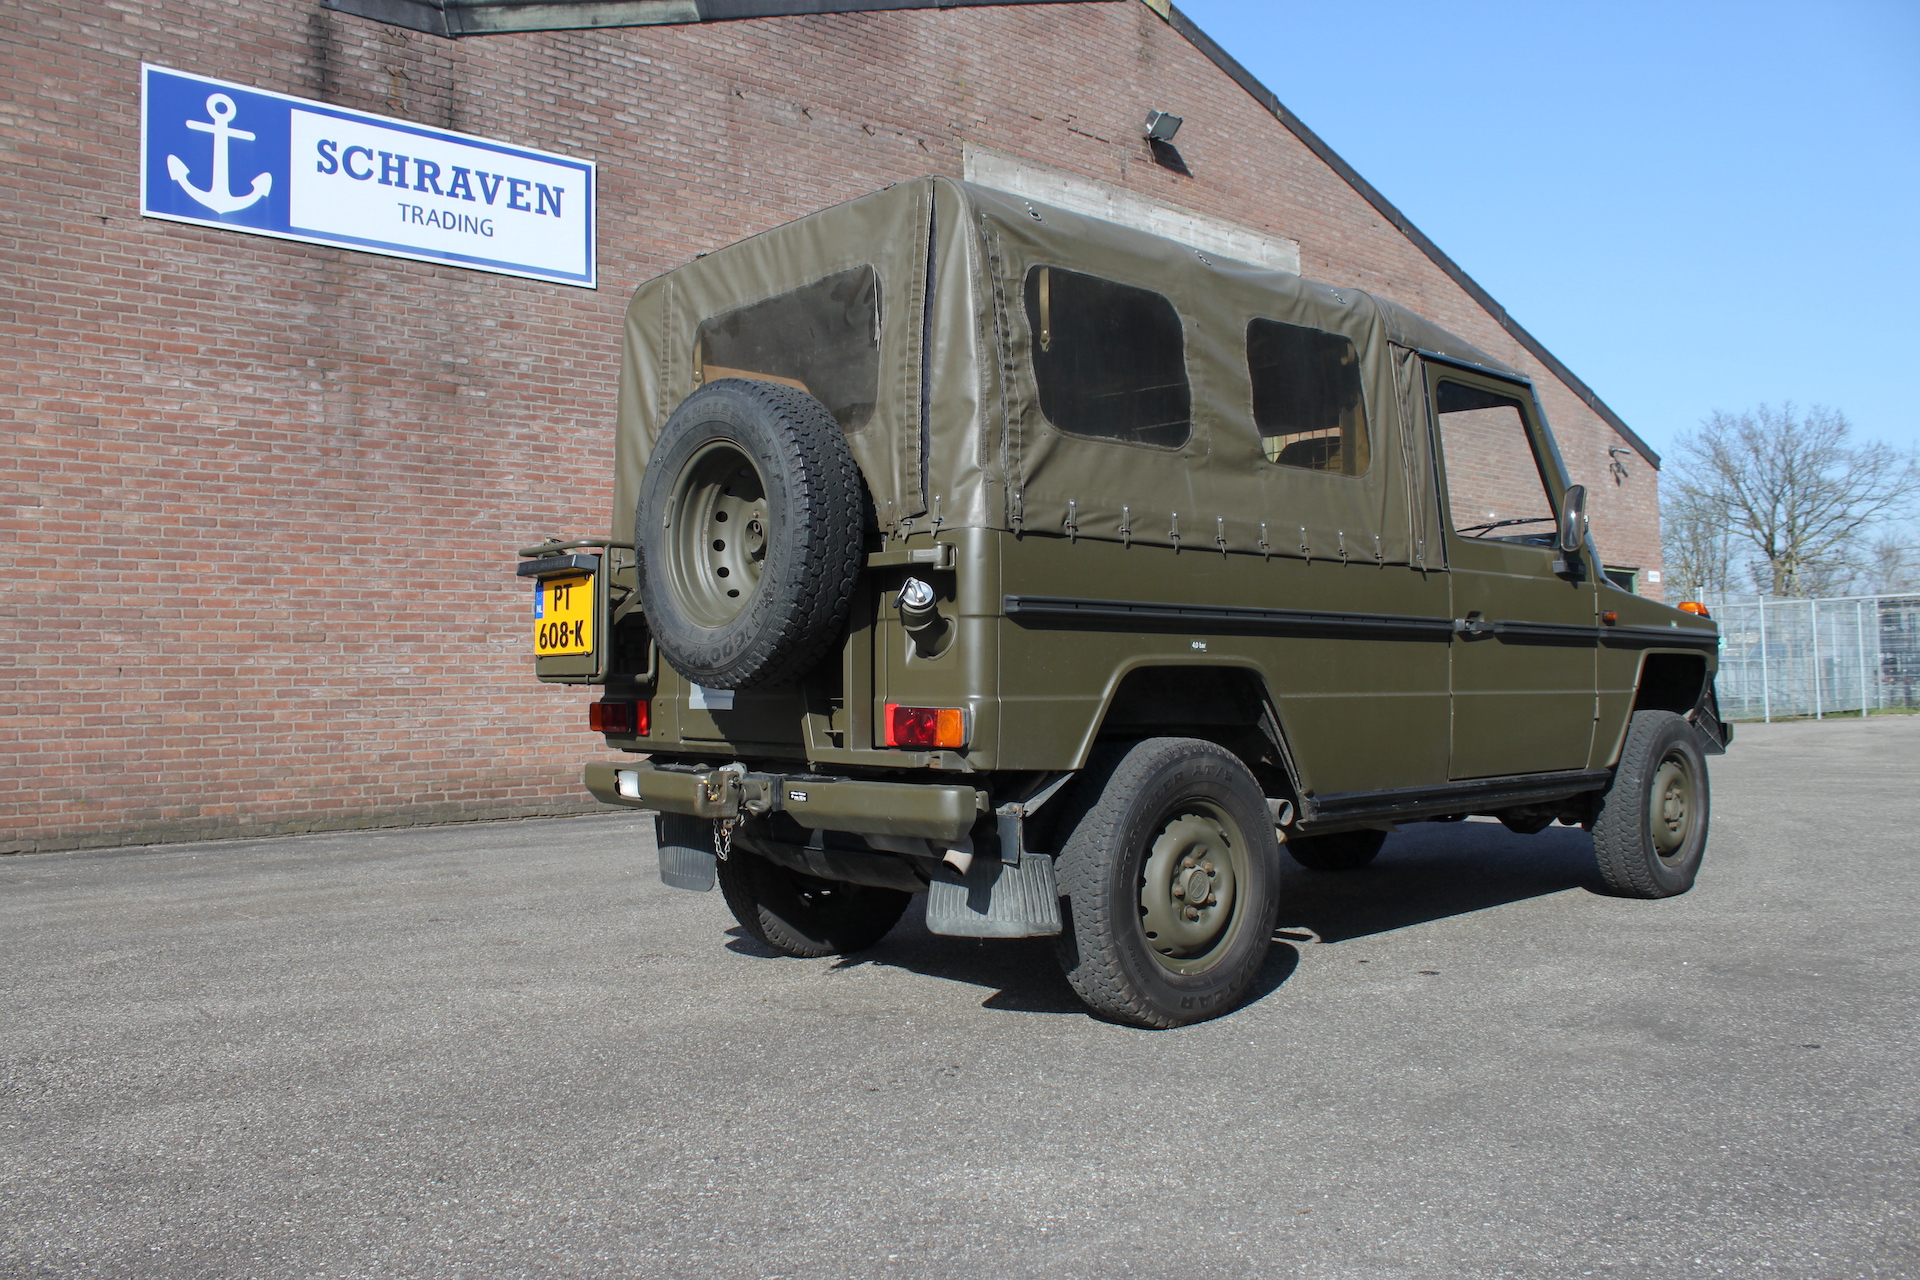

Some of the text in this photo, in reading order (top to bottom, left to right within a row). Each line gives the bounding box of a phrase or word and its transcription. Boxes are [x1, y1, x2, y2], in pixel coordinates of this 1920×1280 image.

[316, 138, 565, 218] SCHRAVEN
[398, 203, 494, 237] TRADING
[536, 605, 543, 613] NL
[554, 583, 573, 612] PT
[539, 620, 584, 650] 608-K
